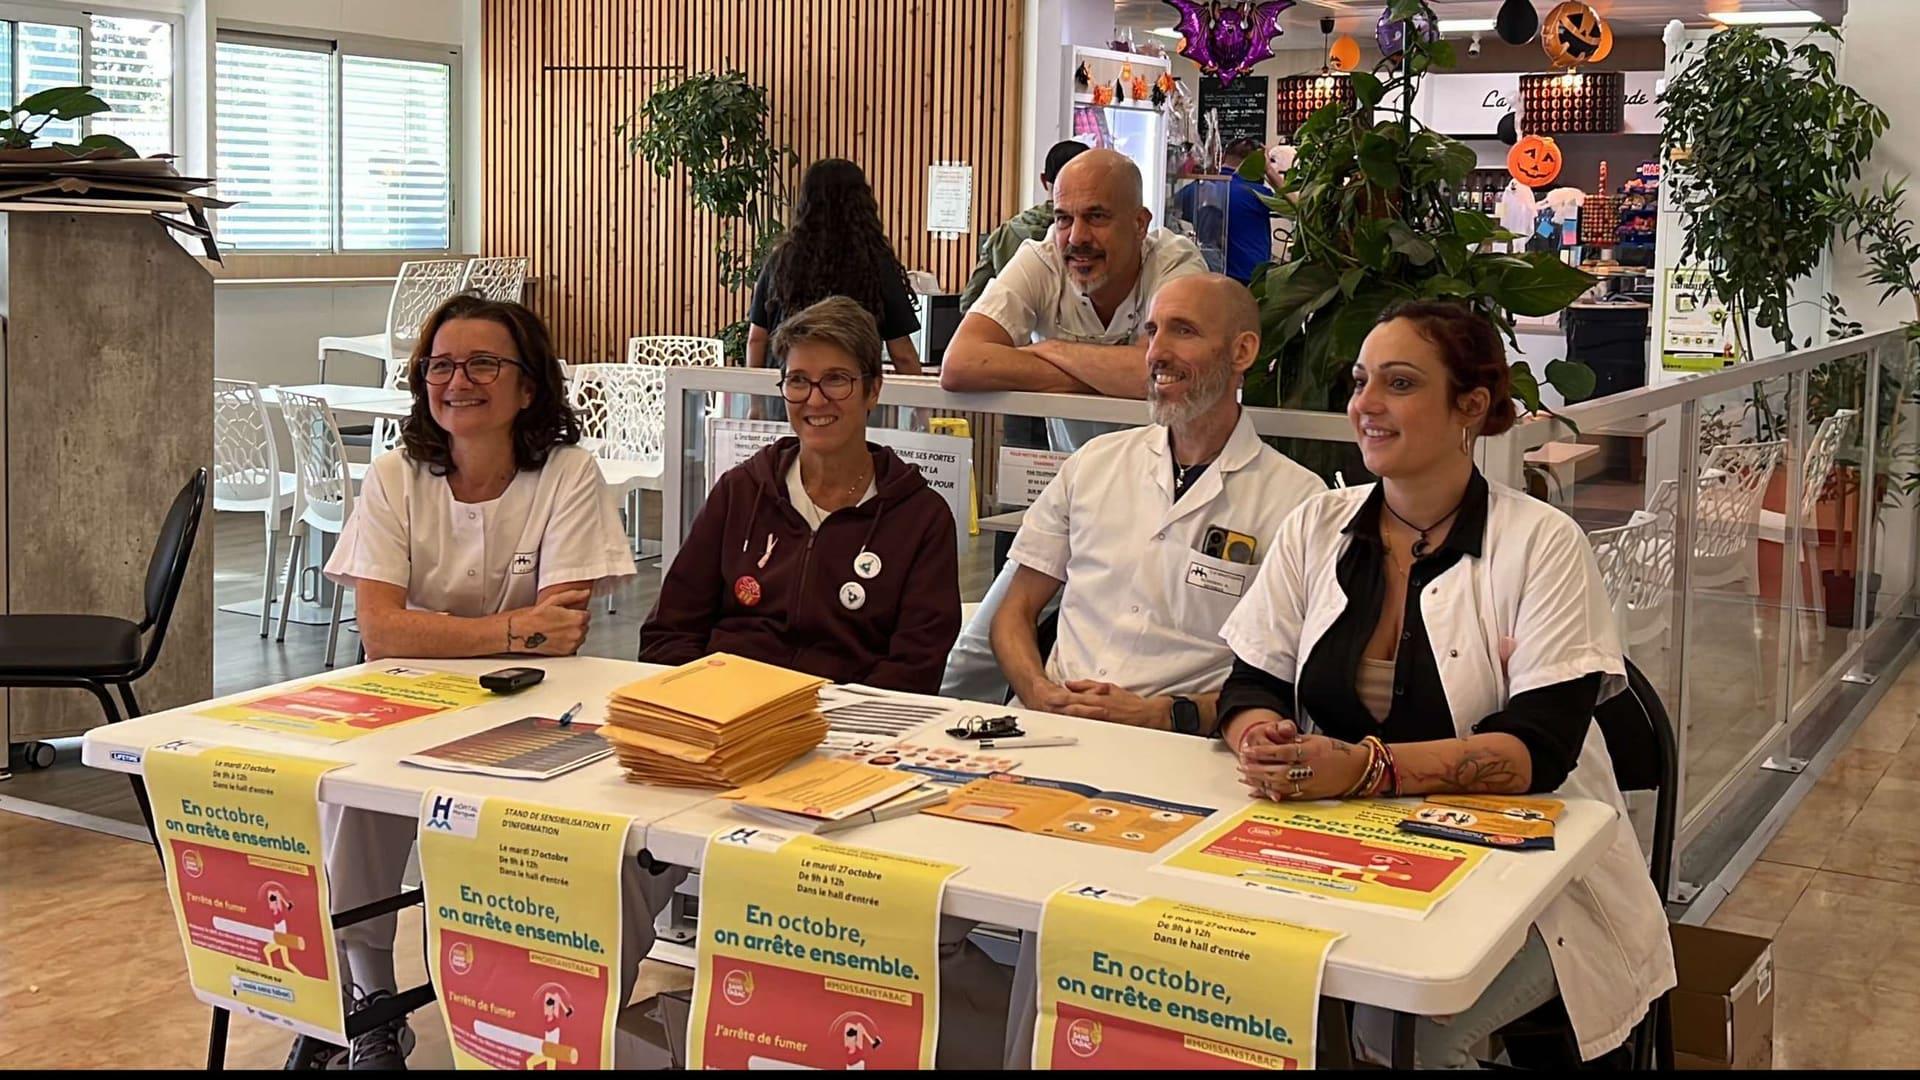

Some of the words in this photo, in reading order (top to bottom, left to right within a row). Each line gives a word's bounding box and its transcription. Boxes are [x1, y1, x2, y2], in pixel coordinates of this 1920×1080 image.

[1482, 90, 1507, 108] La
[915, 451, 928, 460] SES
[929, 453, 956, 463] PORTES
[930, 466, 938, 474] LA
[934, 480, 954, 489] POUR
[215, 760, 224, 768] Le
[224, 761, 242, 770] mardi
[242, 763, 250, 771] 27
[250, 765, 276, 774] octobre
[213, 781, 229, 790] Dans
[181, 799, 202, 816] En
[205, 804, 269, 830] octobre,
[505, 807, 529, 818] STAND
[529, 811, 539, 820] DE
[540, 813, 600, 830] SENSIBILISATION
[601, 823, 611, 831] ET
[165, 818, 184, 833] on
[186, 822, 230, 841] arrête
[232, 831, 311, 855] ensemble.
[502, 820, 560, 836] D'INFORMATION
[499, 844, 507, 852] Le
[508, 845, 530, 855] mardi
[531, 848, 539, 857] 27
[539, 851, 569, 863] octobre
[499, 855, 508, 864] De
[526, 860, 538, 868] 12h
[499, 867, 517, 877] Dans
[517, 869, 524, 878] le
[525, 871, 539, 881] hall
[540, 874, 569, 886] d'entrée
[798, 870, 810, 881] De
[811, 873, 822, 883] 9h
[822, 874, 828, 884] à
[830, 876, 845, 887] 12h
[801, 858, 811, 868] Le
[812, 860, 837, 872] mardi
[837, 864, 848, 874] 27
[848, 868, 882, 881] octobre
[460, 885, 482, 905] En
[487, 894, 560, 923] octobre,
[796, 883, 817, 896] Dans
[818, 886, 826, 897] le
[828, 888, 843, 900] hall
[845, 891, 880, 907] d'entrée
[439, 906, 459, 922] on
[462, 911, 512, 934] arrête
[515, 923, 604, 954] ensemble.
[746, 903, 773, 927] En
[778, 914, 866, 947] octobre,
[1157, 920, 1171, 930] De
[1171, 922, 1183, 933] 9h
[1186, 926, 1192, 934] à
[1194, 928, 1211, 939] 12h
[1175, 915, 1204, 926] mardi
[1216, 924, 1257, 936] octobre
[714, 928, 739, 947] on
[743, 934, 806, 959] arrête
[810, 947, 920, 980] ensemble.
[1153, 932, 1177, 946] Dans
[1178, 936, 1188, 948] le
[1189, 939, 1209, 953] hall
[1210, 943, 1251, 961] d'entrée
[1092, 951, 1123, 977] En
[1129, 964, 1232, 1005] octobre,
[477, 1000, 489, 1012] de
[490, 1003, 516, 1019] fumer
[1057, 976, 1086, 995] on
[1090, 982, 1162, 1013] arrête
[1167, 1001, 1293, 1044] ensemble.
[715, 1023, 755, 1042] J'arrête
[757, 1033, 772, 1045] de
[774, 1035, 808, 1052] fumer
[1185, 1038, 1278, 1067] #MOISSANSTABAC
